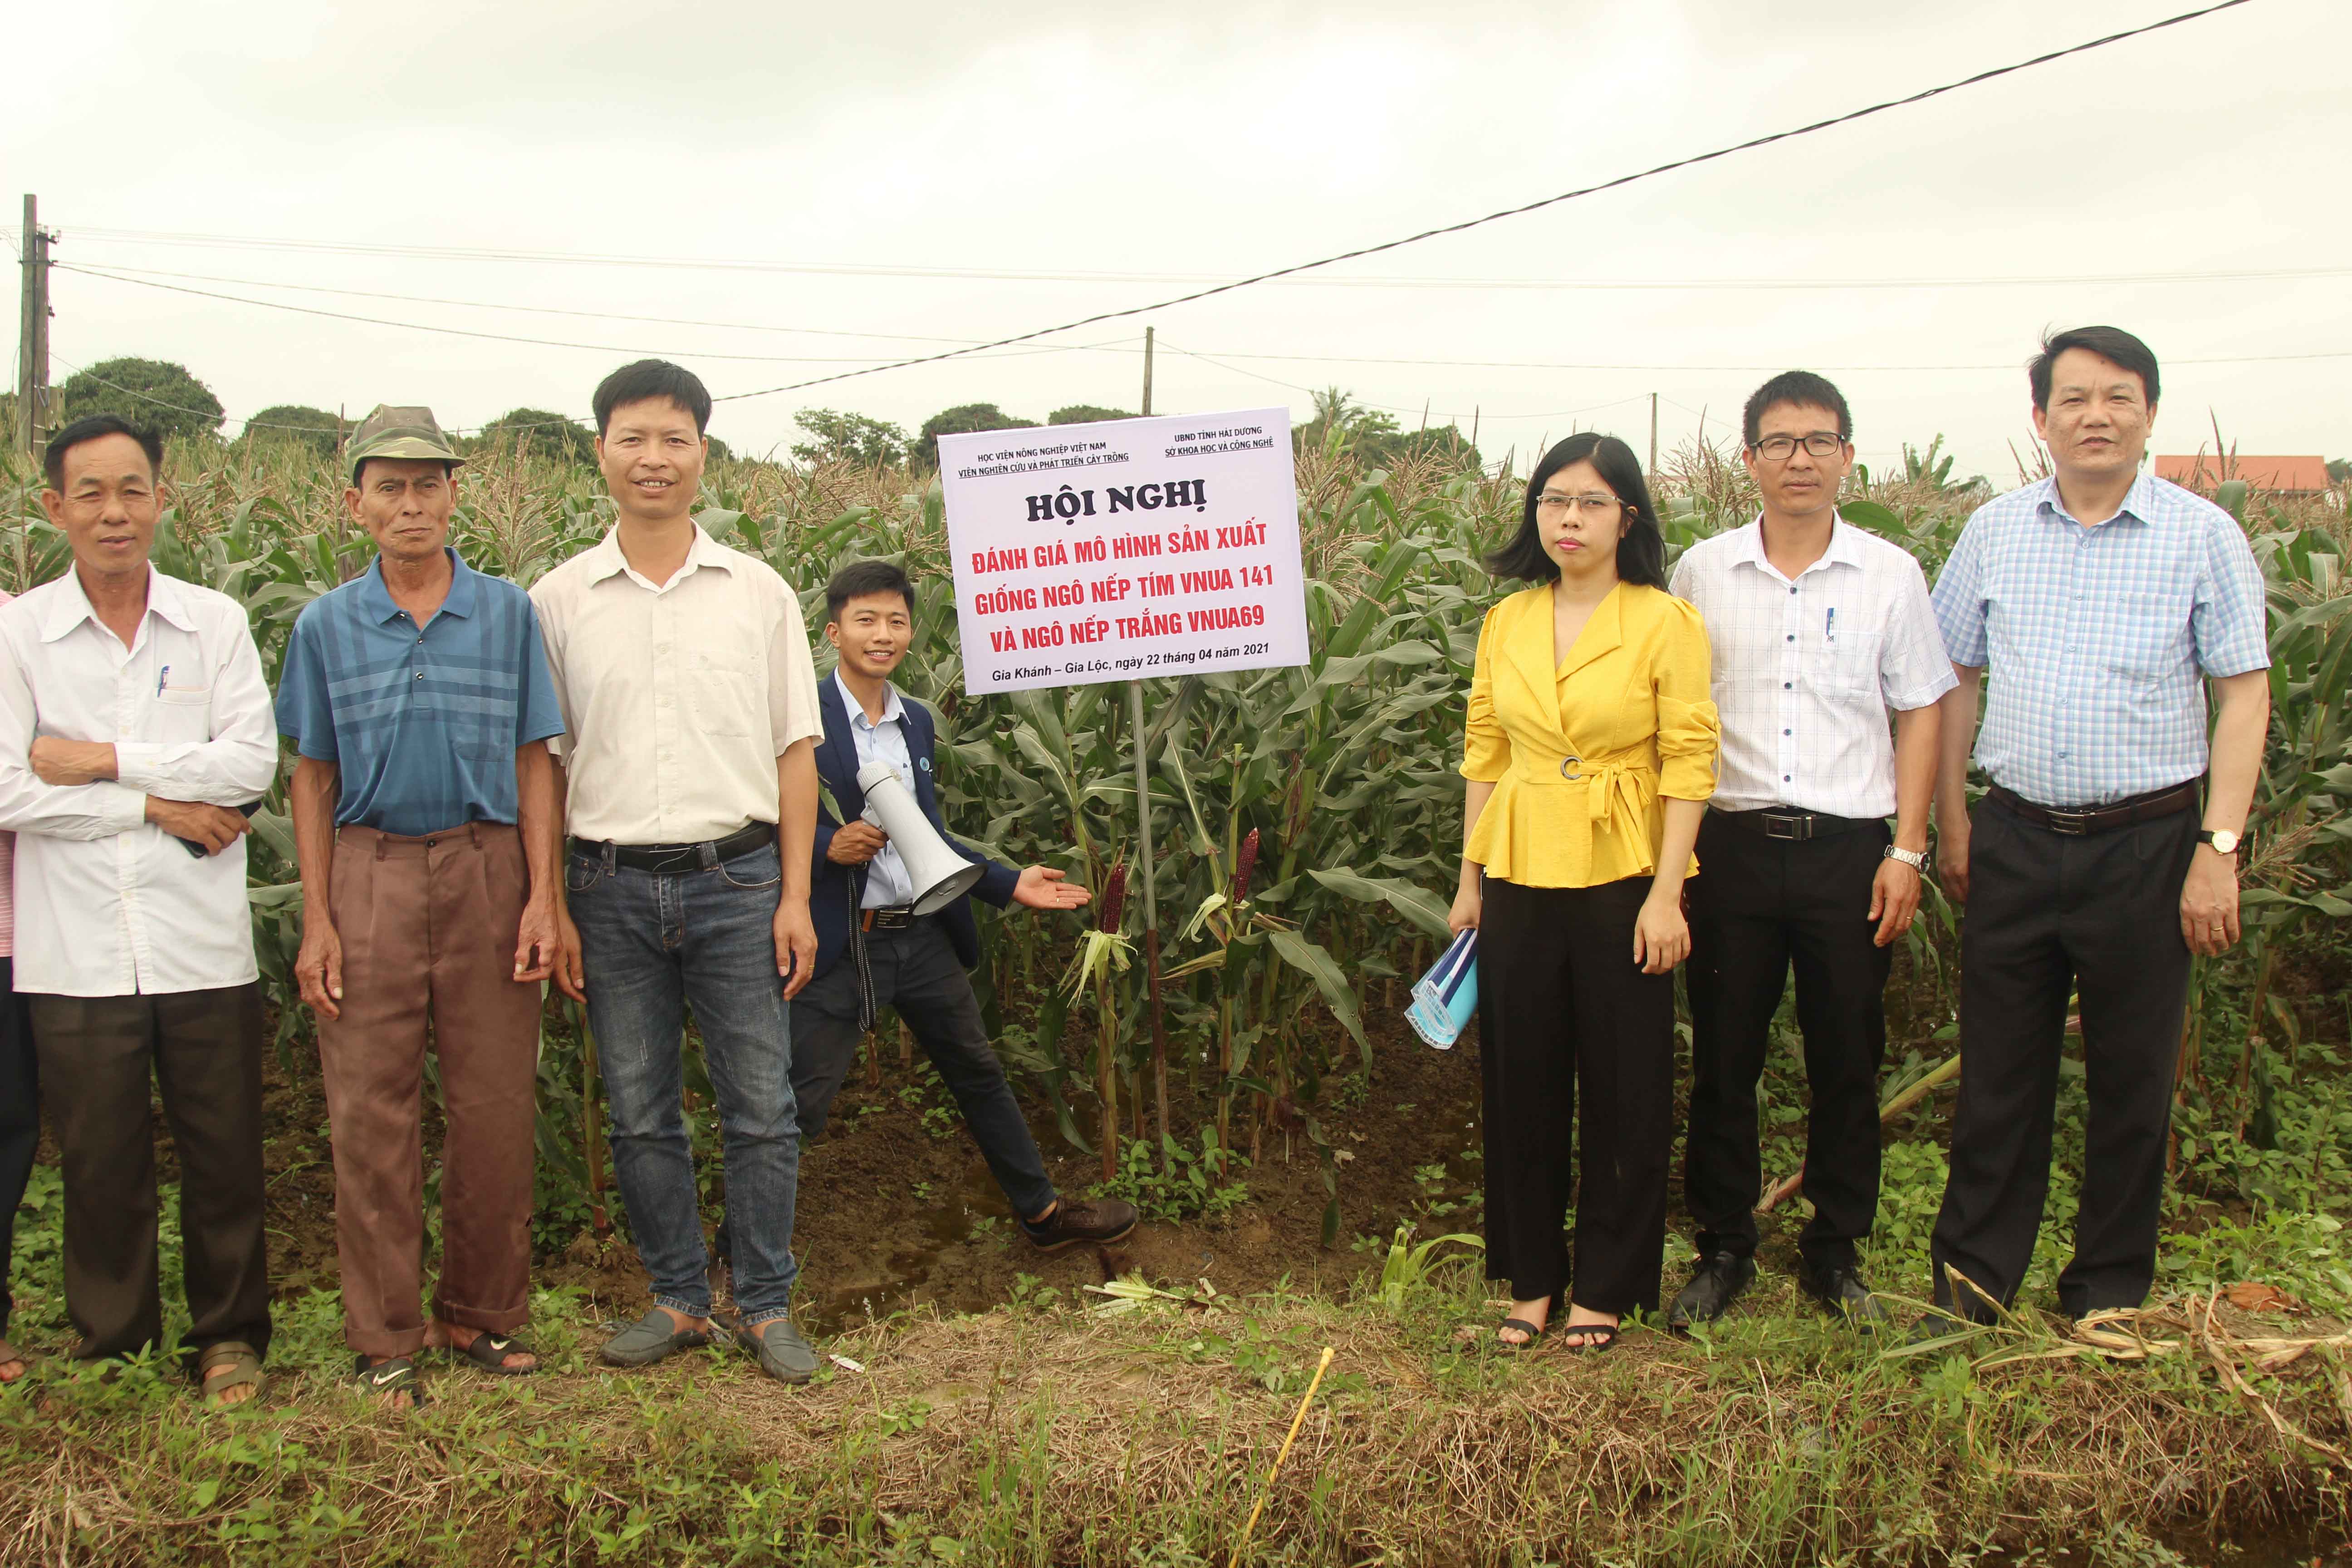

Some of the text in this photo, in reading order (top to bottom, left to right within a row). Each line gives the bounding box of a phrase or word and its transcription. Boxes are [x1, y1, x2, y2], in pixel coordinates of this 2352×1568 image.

[977, 441, 1107, 463] HỌC VIỆN NÔNG NGHIỆP VIỆT NAM
[1165, 436, 1274, 457] SỞ KHOA HỌC VÀ CÔNG NGHỆ
[1174, 426, 1262, 442] UBND TỈNH HẢI DƯƠNG
[958, 466, 977, 478] VIỆN
[979, 463, 1008, 475] NGHIÊN
[1009, 462, 1026, 472] CỨU
[1027, 459, 1039, 470] VÀ
[1039, 457, 1059, 469] PHÁT
[1086, 453, 1101, 464] CÂY
[1102, 451, 1129, 463] TRỒNG
[1025, 479, 1207, 526] HỘI NGHỊ
[971, 516, 1267, 574] ĐÁNH GIÁ MÔ HÌNH SẢN XUẤT
[975, 564, 1273, 616] GIỐNG NGÔ NẾP TÍM VNUA 141
[990, 604, 1264, 652] VÀ NGÔ NẾP TRẮNG VNUA69
[992, 669, 1011, 681] Gia
[1014, 665, 1052, 679] Khánh
[1065, 662, 1084, 674] Gia
[1087, 659, 1112, 673] Lộc,
[1115, 656, 1144, 671] ngày
[1147, 653, 1160, 666] 22
[1162, 651, 1196, 664] tháng
[1198, 648, 1212, 660] 04
[1215, 646, 1240, 658] năm
[1243, 642, 1269, 656] 2021
